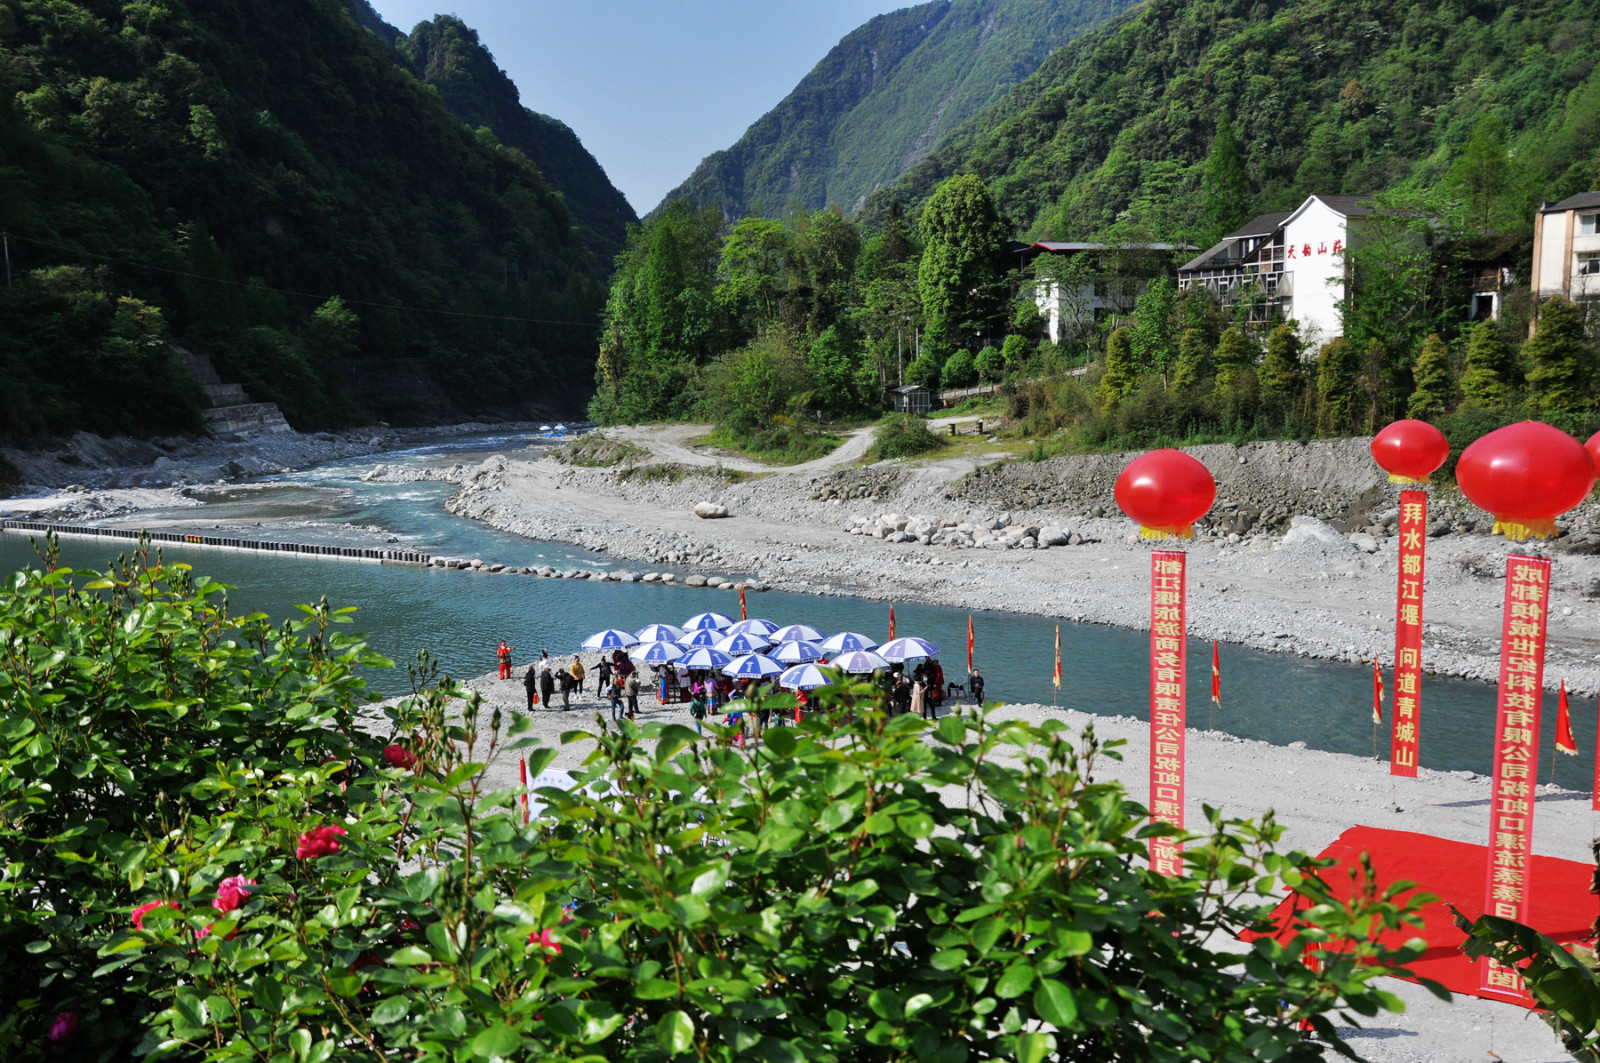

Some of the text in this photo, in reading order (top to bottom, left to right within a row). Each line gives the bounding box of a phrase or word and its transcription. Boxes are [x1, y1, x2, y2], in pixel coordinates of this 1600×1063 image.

[1395, 503, 1422, 767] 拜水都江堰 问道青城山
